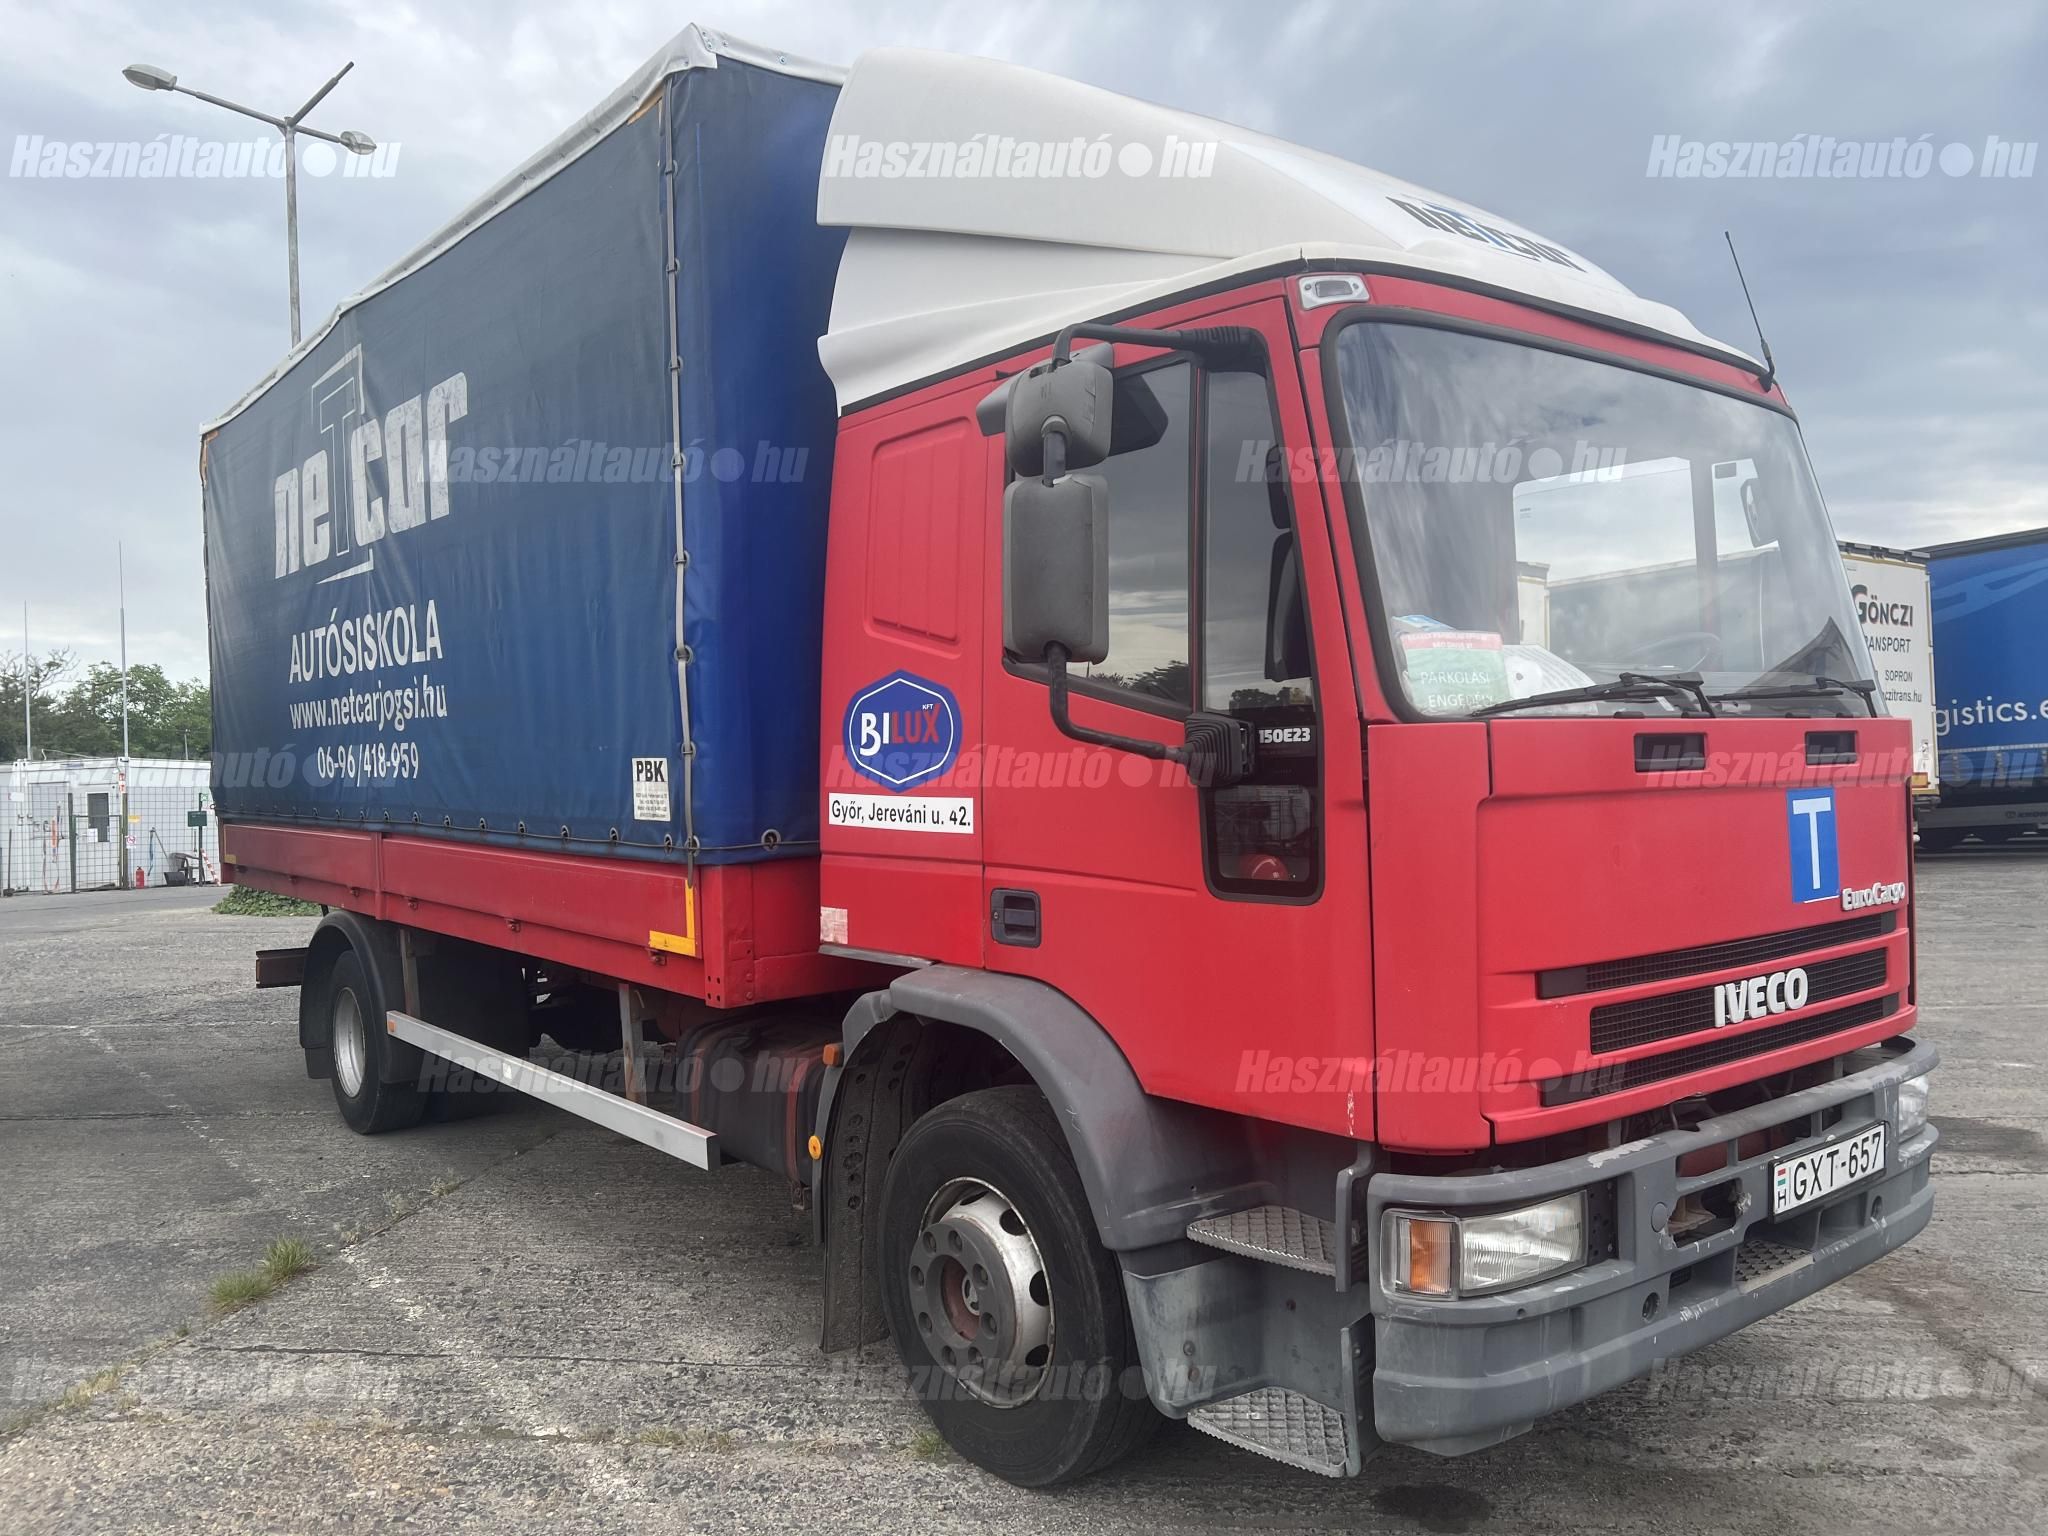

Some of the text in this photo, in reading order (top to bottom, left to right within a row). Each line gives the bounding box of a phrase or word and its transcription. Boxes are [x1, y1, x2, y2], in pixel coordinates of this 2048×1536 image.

[1851, 584, 1914, 627] GÖNCZI
[289, 599, 443, 684] AUTÓSISKOLA
[1885, 669, 1913, 682] SOPRON
[289, 674, 448, 732] www.netcarjogsi.hu
[859, 703, 941, 757] BILUX
[636, 760, 665, 782] PBK
[831, 799, 971, 826] Győr, Jereváni u. 42.
[1841, 881, 1906, 911] EuroCargo
[1713, 967, 1809, 1028] IVECO
[1793, 1131, 1882, 1201] GXT-657
